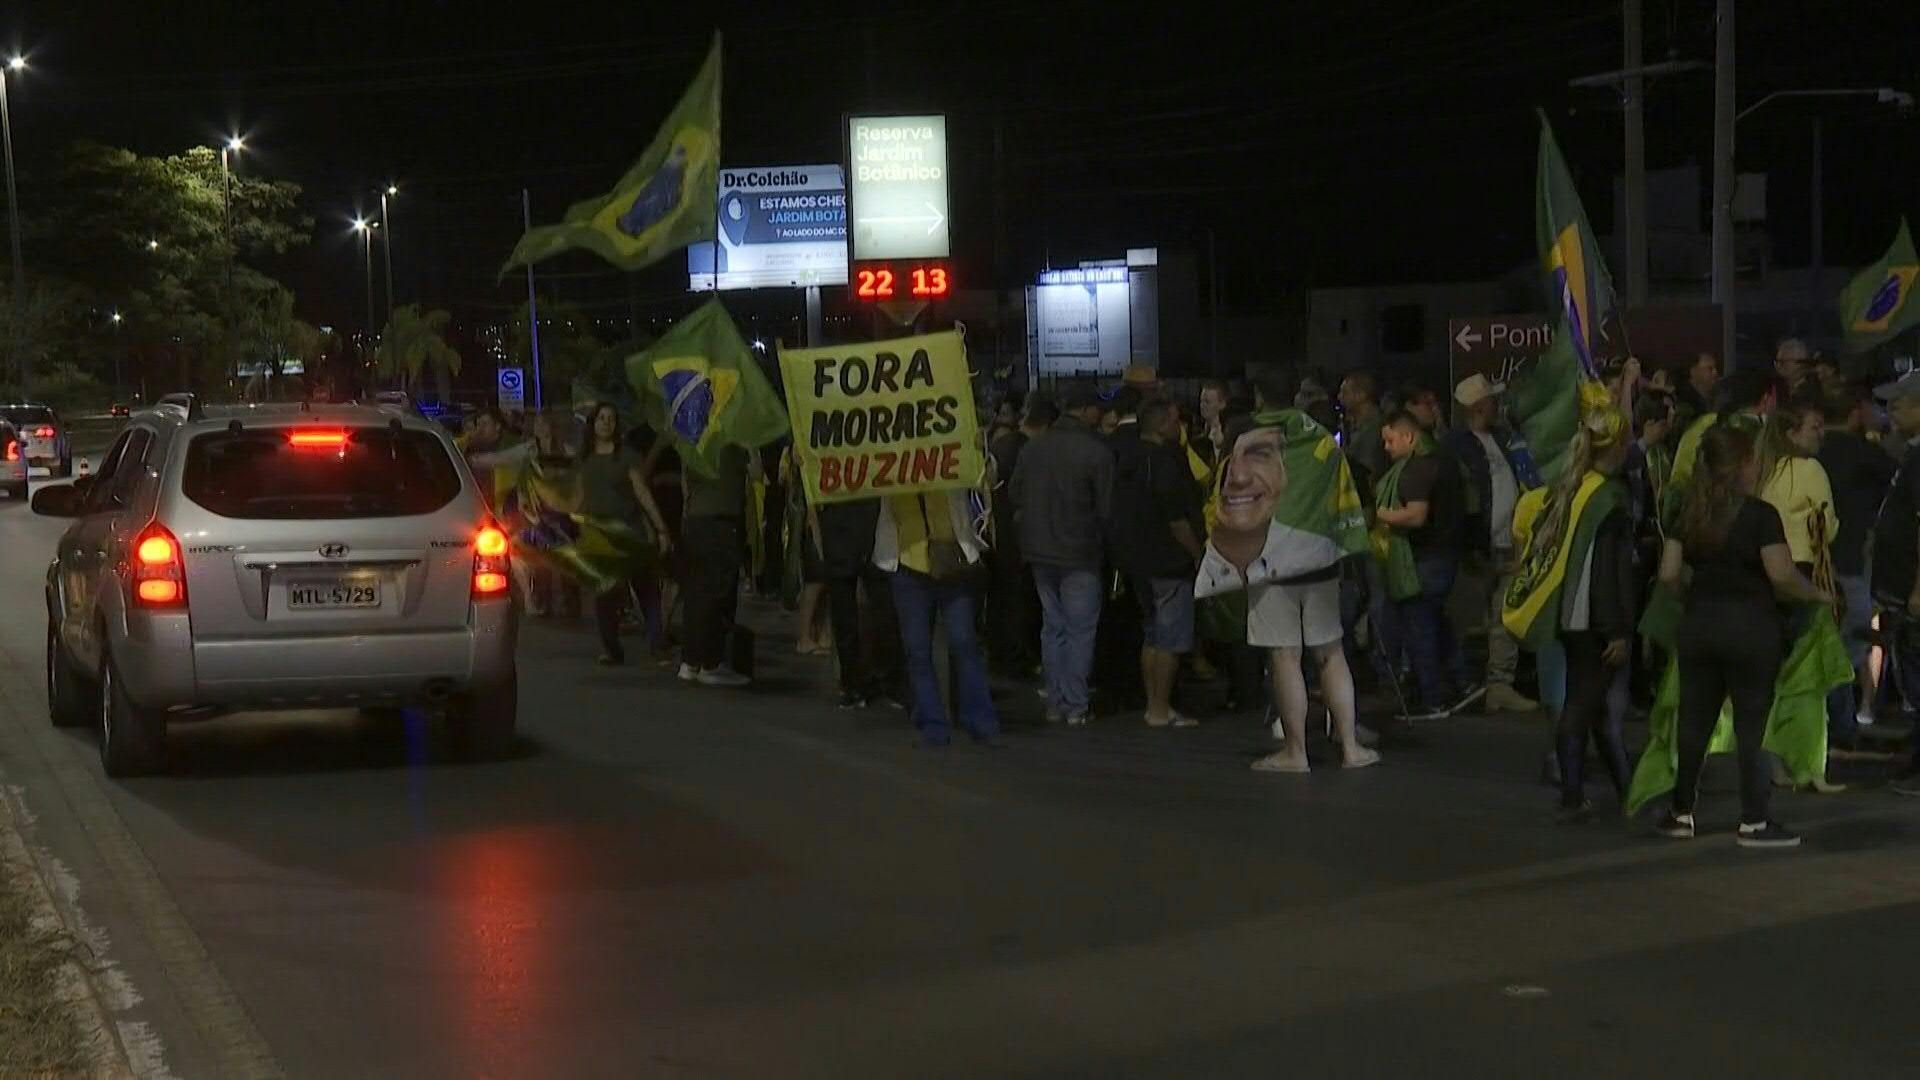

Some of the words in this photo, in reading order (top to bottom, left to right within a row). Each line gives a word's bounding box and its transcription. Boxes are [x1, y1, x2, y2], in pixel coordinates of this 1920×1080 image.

[857, 125, 933, 141] Reserva
[857, 142, 923, 162] Jardim
[858, 163, 942, 182] Botânico
[760, 196, 817, 210] ESTAMOS
[768, 211, 814, 224] JARDIM
[782, 228, 794, 238] AO
[794, 227, 813, 237] LADO
[813, 227, 825, 237] DO
[858, 270, 894, 296] 22
[912, 268, 947, 295] 13
[1489, 322, 1556, 348] Pont
[813, 348, 934, 398] FORA
[810, 395, 958, 449] MORAES
[819, 442, 962, 496] BUZINE
